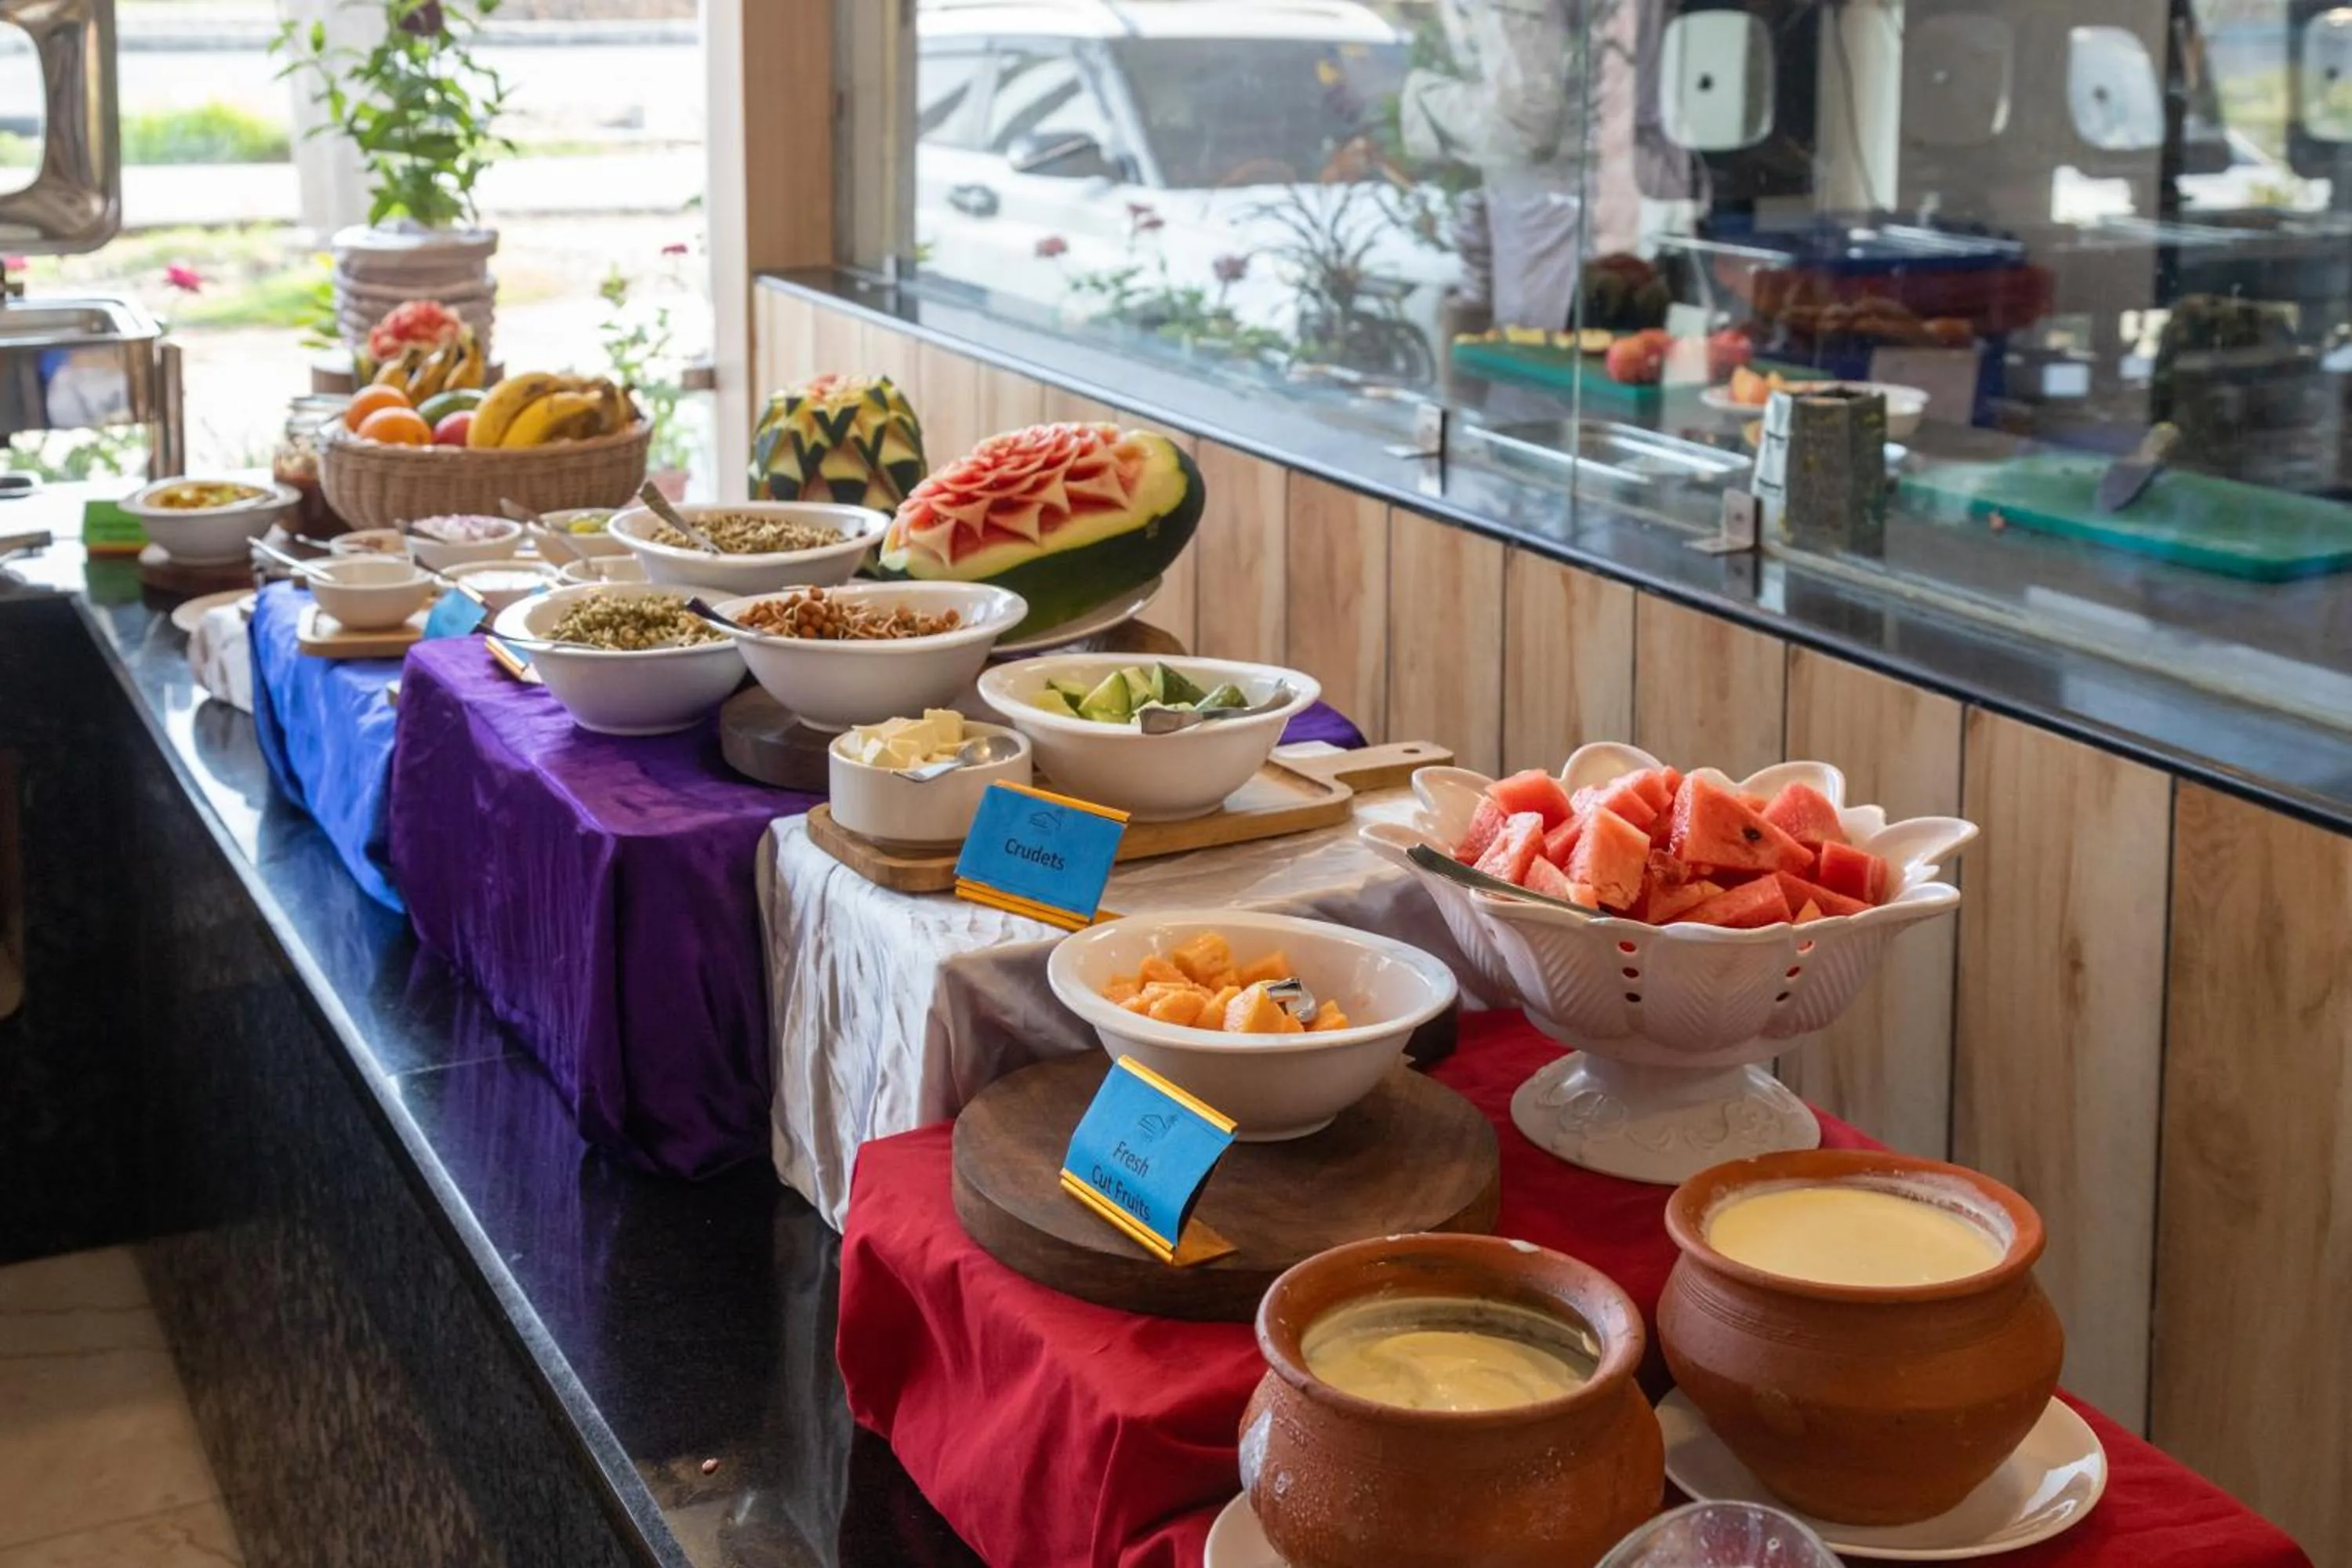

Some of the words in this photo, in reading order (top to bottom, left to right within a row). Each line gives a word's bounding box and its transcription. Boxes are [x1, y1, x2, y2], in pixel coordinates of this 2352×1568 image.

[1004, 837, 1065, 871] Crudets
[1112, 1141, 1150, 1178] Fresh
[1091, 1164, 1112, 1194] Cut
[1114, 1181, 1151, 1222] Fruits
